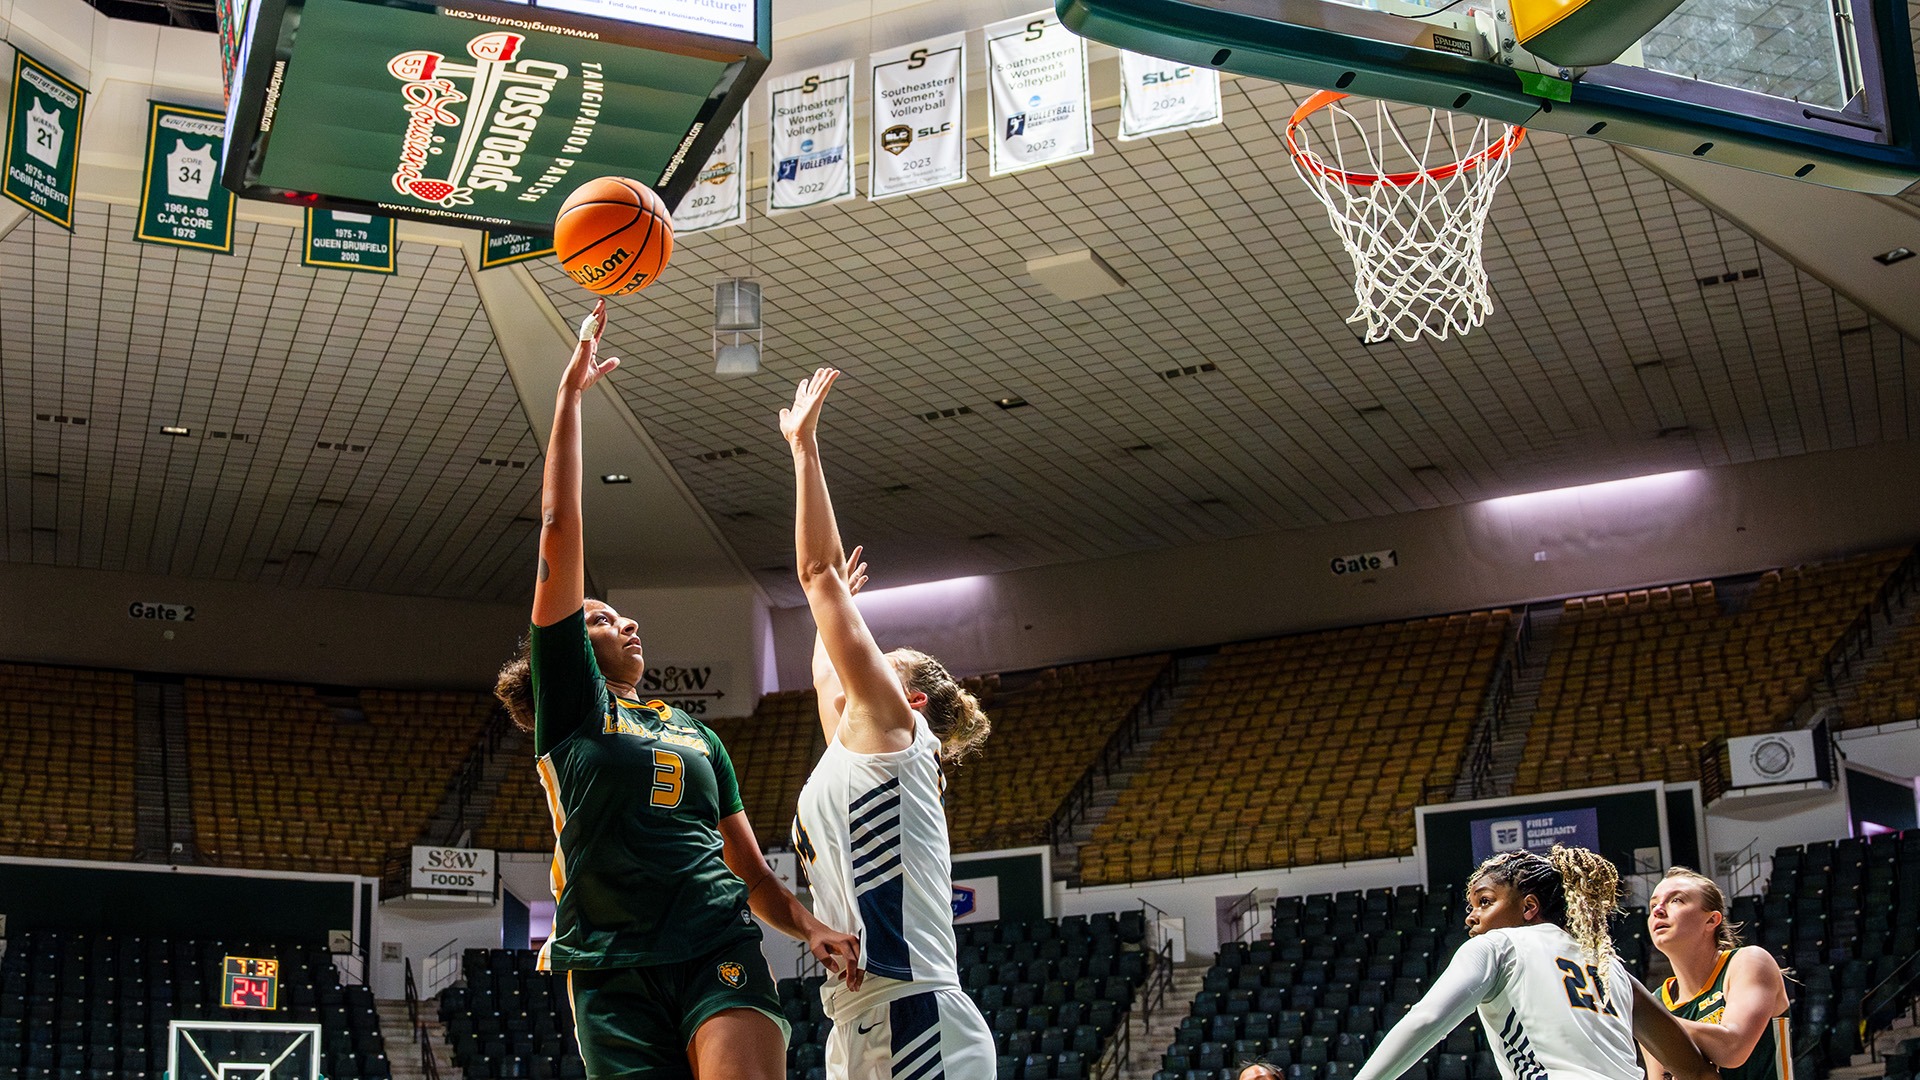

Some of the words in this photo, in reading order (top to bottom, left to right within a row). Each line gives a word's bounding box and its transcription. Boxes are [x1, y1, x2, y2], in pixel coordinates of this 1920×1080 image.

[445, 8, 599, 39] www.tangitourism.com
[668, 11, 744, 28] LouisianaPropane.com
[1025, 19, 1045, 42] S
[480, 42, 500, 54] 12
[1435, 36, 1469, 50] SPALDING
[401, 58, 421, 75] 55
[907, 48, 928, 70] S
[997, 47, 1075, 72] Southeastern
[1010, 61, 1064, 79] Women's
[1142, 66, 1190, 86] SLC
[802, 75, 820, 94] S
[881, 76, 955, 99] Southeastern
[1008, 70, 1066, 90] Volleyball
[260, 60, 286, 132] www.tangitourism.com
[892, 89, 944, 107] Women's
[1152, 96, 1185, 111] 2024
[561, 62, 603, 154] TANGIPAHOA
[777, 95, 845, 117] Southeastern
[890, 98, 946, 118] Volleyball
[1028, 104, 1075, 122] VOLLEYBALL
[467, 59, 569, 192] Crossroads
[788, 109, 834, 127] Women's
[786, 118, 836, 138] Volleyball
[917, 121, 951, 138] SLC
[37, 128, 52, 149] 21
[394, 84, 459, 194] Louisiana
[1026, 138, 1056, 153] 2023
[181, 157, 202, 166] CORE
[657, 122, 704, 187] www.tangitourism.com
[902, 157, 931, 171] 2023
[25, 163, 42, 179] 1979
[47, 175, 57, 187] 83
[179, 167, 201, 184] 34
[518, 158, 574, 202] PARISH
[10, 166, 33, 188] ROBIN
[34, 179, 69, 206] ROBERTS
[798, 182, 824, 195] 2022
[30, 191, 47, 206] 2011
[691, 195, 716, 208] 2022
[164, 203, 188, 214] 1964
[196, 207, 209, 217] 68
[378, 202, 511, 225] www.tangitourism.com
[157, 213, 178, 225] C.A.
[181, 217, 213, 230] CORE
[172, 227, 196, 239] 1975
[335, 228, 352, 238] 1975
[358, 230, 367, 240] 79
[313, 238, 341, 249] QUEEN
[342, 241, 387, 253] BRUMFIELD
[510, 242, 531, 255] 2012
[341, 252, 360, 262] 2003
[1331, 556, 1381, 575] Gate
[1388, 550, 1398, 566] 1
[129, 602, 177, 620] Gate
[184, 606, 195, 621] 2
[643, 666, 711, 691] S&W
[650, 748, 685, 809] 3
[1526, 817, 1553, 828] FIRST
[1527, 825, 1577, 837] GUARANTY
[1528, 838, 1553, 848] BANK
[428, 850, 477, 868] S&W
[432, 874, 474, 886] FOODS
[236, 959, 276, 976] 7:32
[232, 978, 268, 1006] 24
[1554, 956, 1619, 1018] 21
